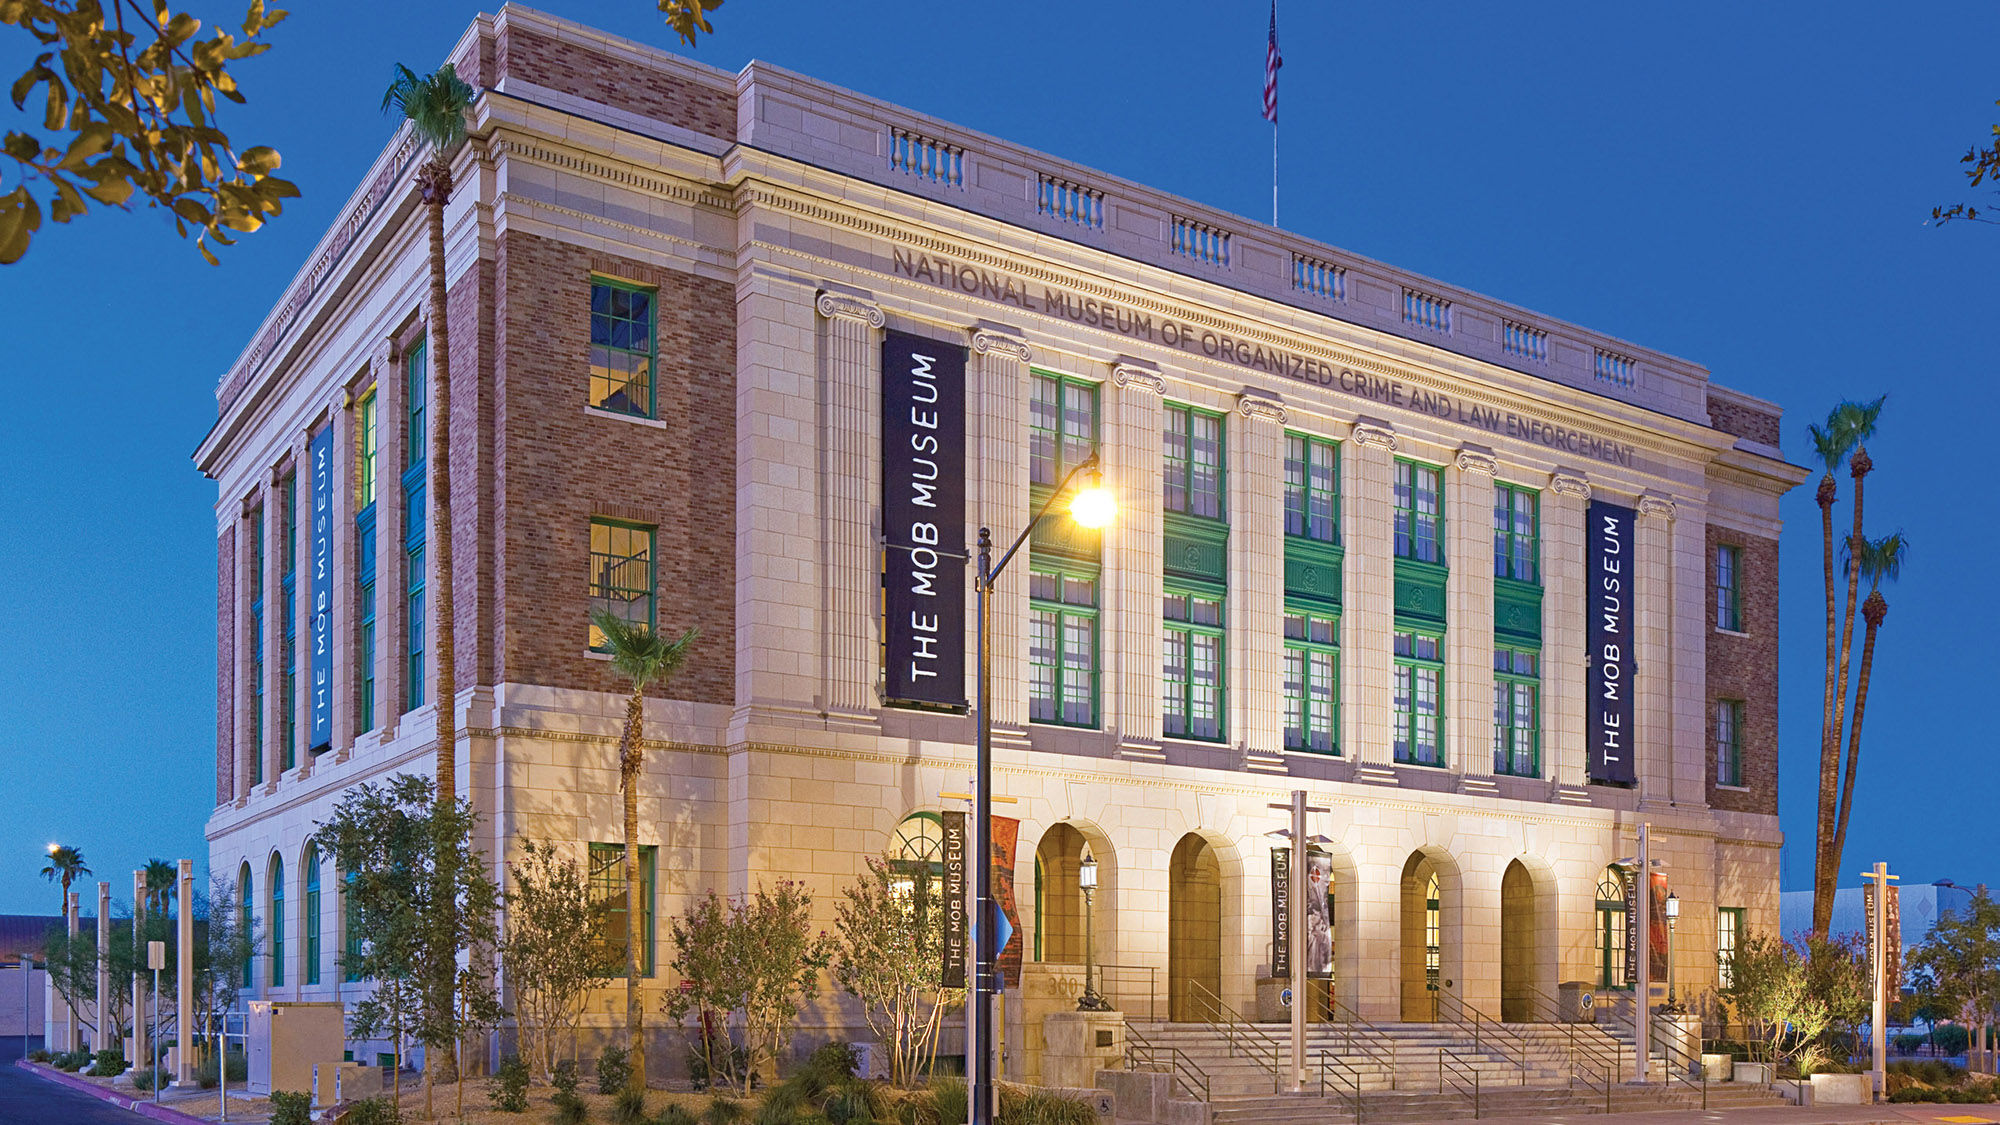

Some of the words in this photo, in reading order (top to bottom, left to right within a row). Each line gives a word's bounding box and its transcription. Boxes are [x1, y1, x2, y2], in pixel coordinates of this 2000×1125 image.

[893, 245, 1037, 309] NATIONAL
[1045, 285, 1152, 341] MUSEUM
[1161, 318, 1194, 349] OF
[1201, 333, 1333, 386] ORGANIZED
[1340, 370, 1403, 405] CRIME
[1409, 389, 1451, 418] AND
[1458, 401, 1500, 431] LAW
[1507, 414, 1635, 467] ENFORCEMENT
[911, 352, 938, 508] MUSEUM
[317, 446, 326, 581] MUSEUM
[911, 520, 938, 597] MOB
[1603, 515, 1620, 634] MUSEUM
[317, 589, 326, 656] MOB
[911, 609, 938, 683] THE
[316, 666, 326, 732] THE
[1603, 643, 1620, 701] MOB
[1603, 710, 1620, 767] THE
[948, 828, 962, 894] MUSEUM
[1276, 852, 1288, 908] MUSEUM
[950, 899, 961, 932] MOB
[1278, 913, 1288, 941] MOB
[1626, 875, 1637, 924] MUSEUM
[949, 937, 961, 969] THE
[1277, 945, 1287, 972] THE
[1627, 955, 1636, 978] THE
[1047, 977, 1078, 995] 300
